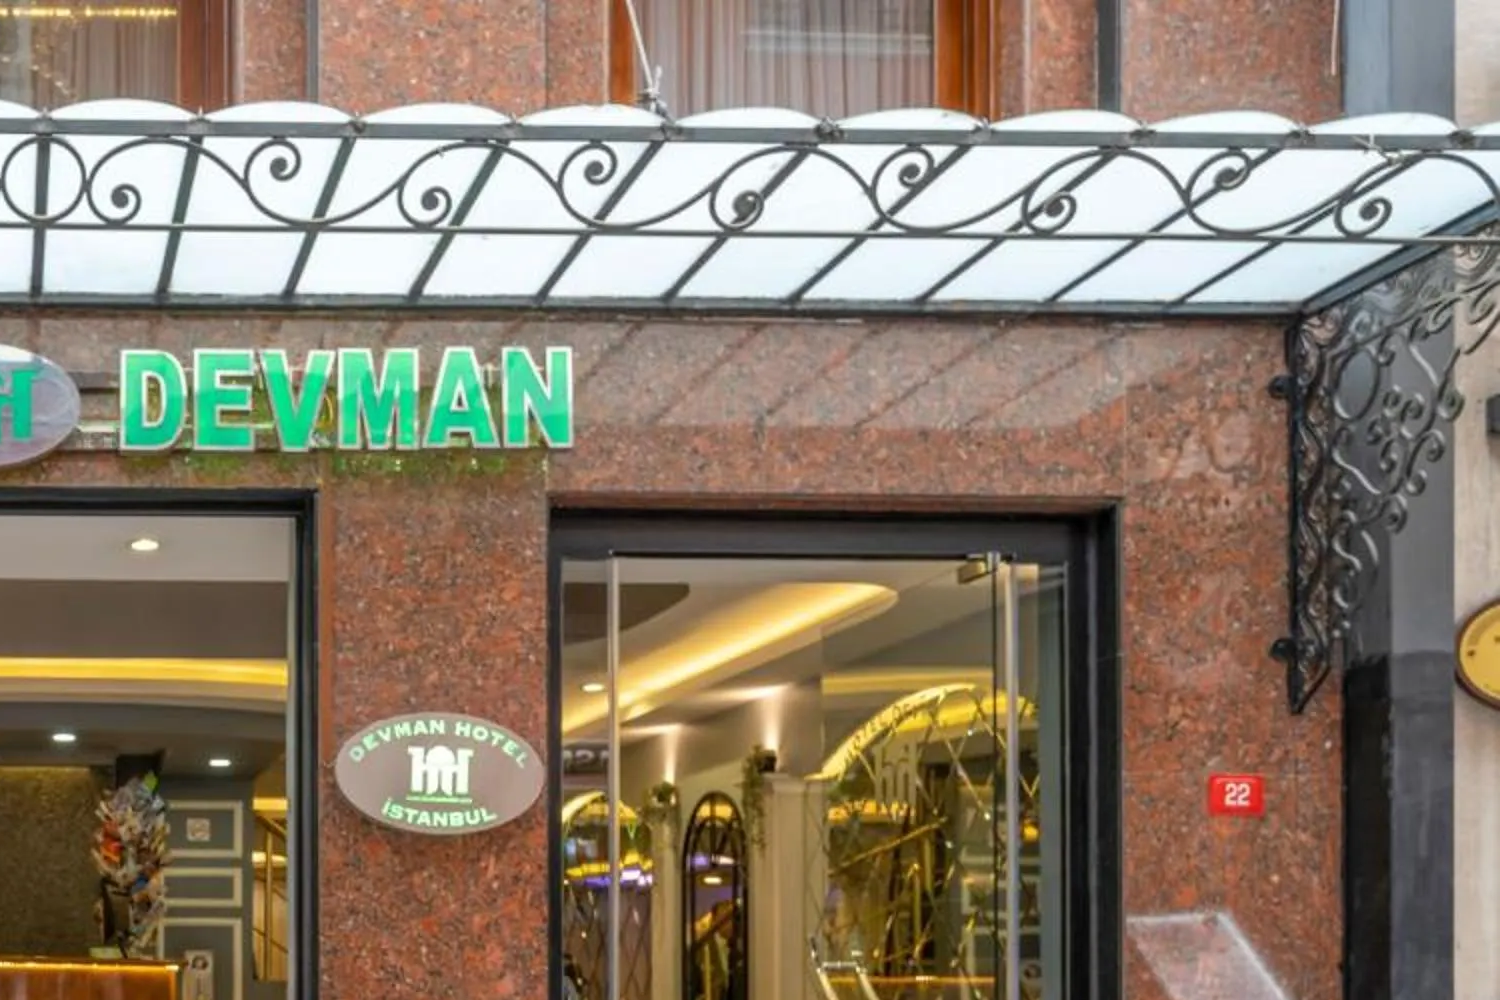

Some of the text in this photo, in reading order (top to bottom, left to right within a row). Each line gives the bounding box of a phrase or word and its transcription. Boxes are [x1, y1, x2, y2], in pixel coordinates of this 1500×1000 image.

[118, 346, 575, 455] DEVMAN
[350, 720, 528, 768] DEVMAN HOTEL
[1224, 783, 1251, 806] 22
